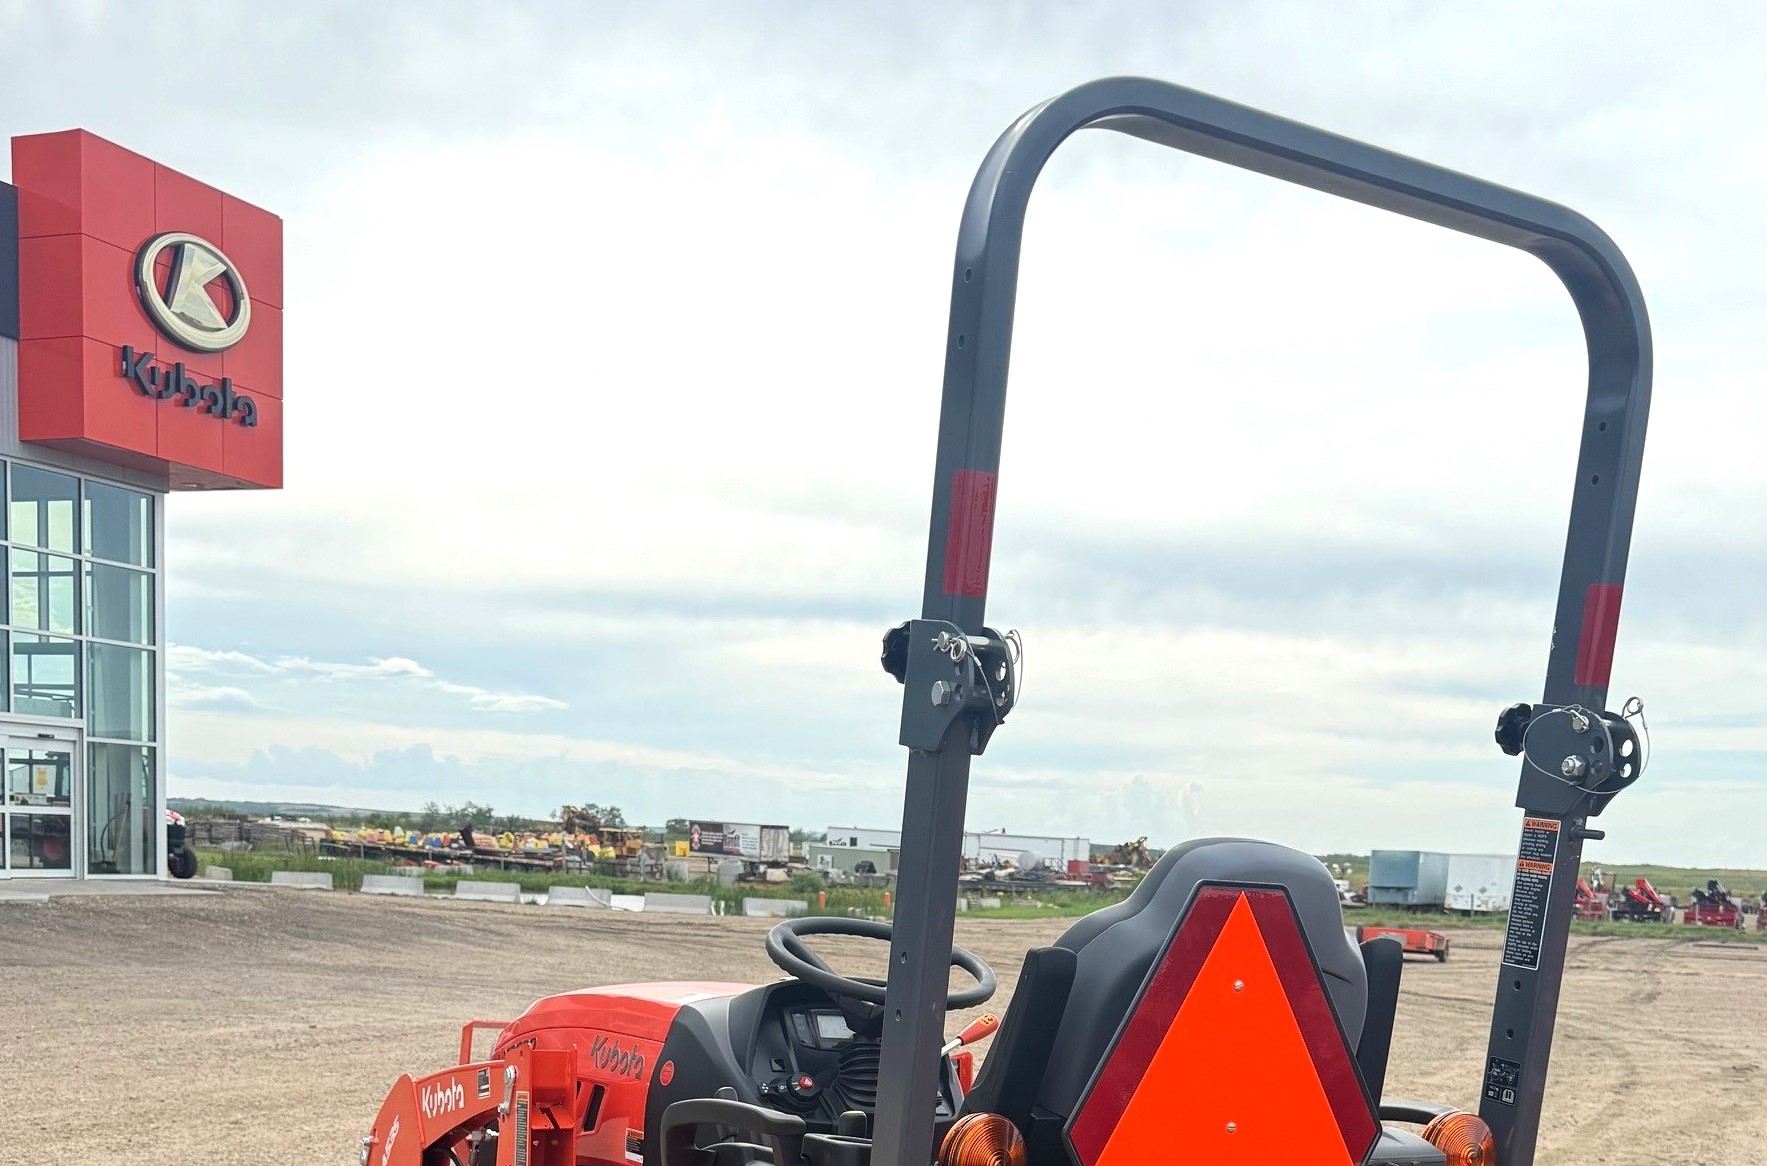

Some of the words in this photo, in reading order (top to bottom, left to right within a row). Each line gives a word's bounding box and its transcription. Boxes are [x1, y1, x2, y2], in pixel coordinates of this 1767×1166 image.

[122, 345, 258, 427] Kubota
[1531, 821, 1557, 830] WARNING
[1525, 861, 1551, 871] WARNING
[590, 1034, 645, 1081] Kubota
[421, 1076, 465, 1119] Kubota
